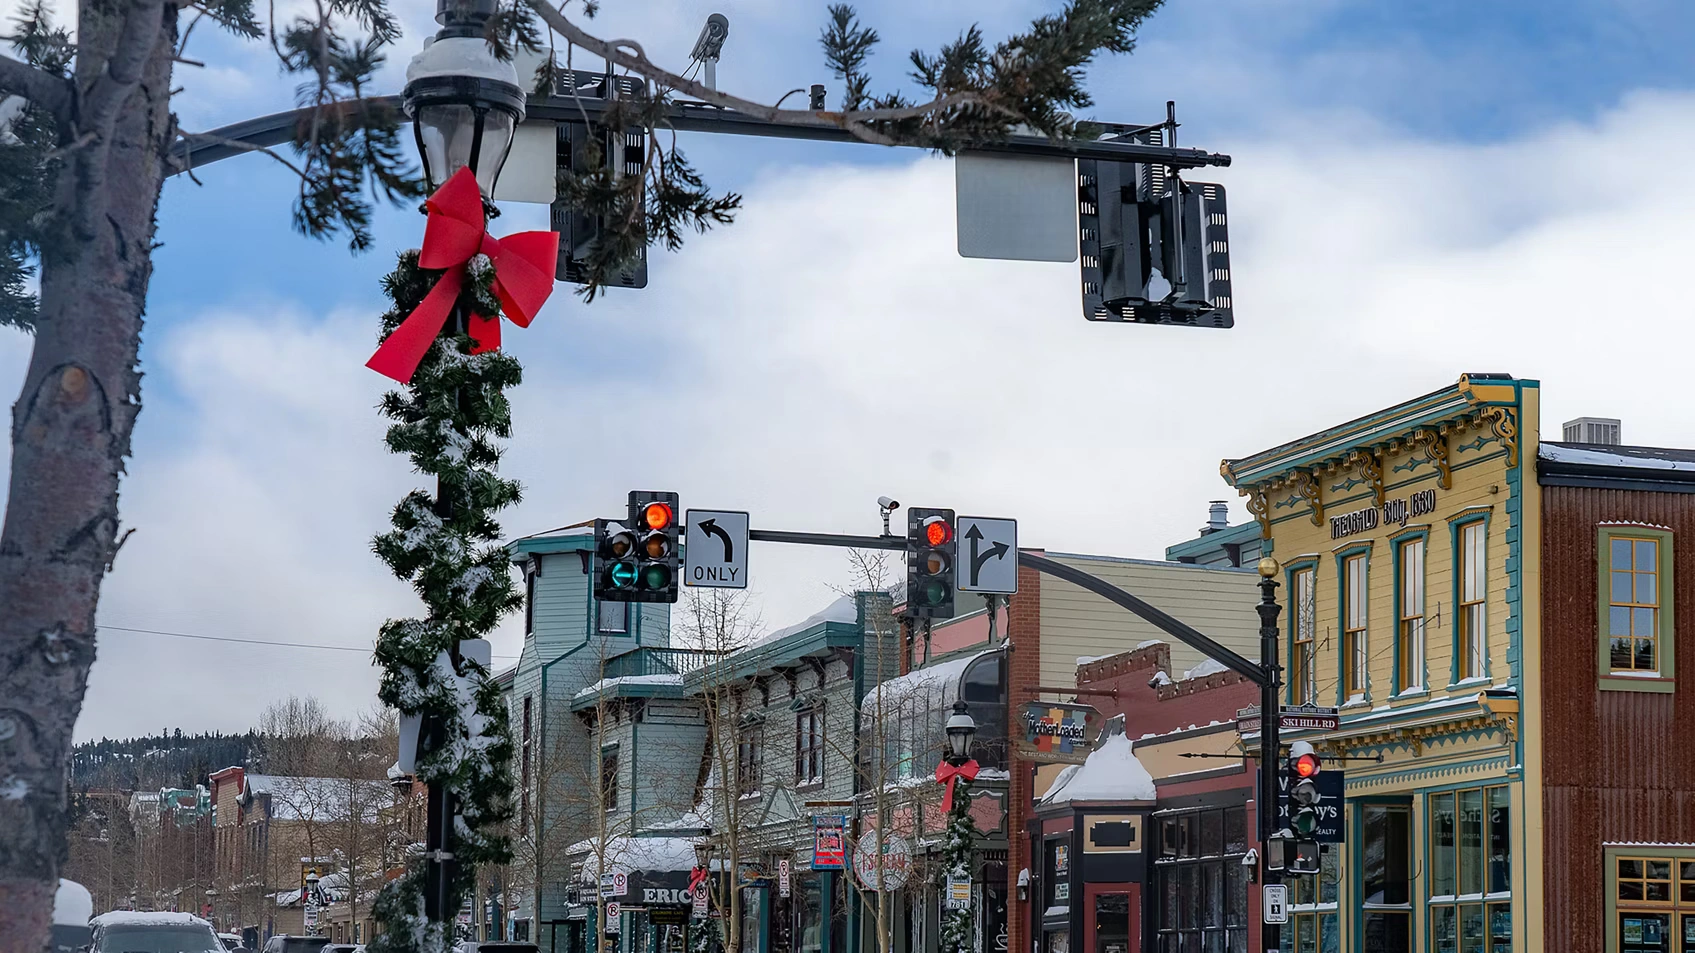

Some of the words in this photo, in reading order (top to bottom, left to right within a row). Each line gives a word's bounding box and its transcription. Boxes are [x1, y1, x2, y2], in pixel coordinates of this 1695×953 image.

[1330, 506, 1379, 540] THEOBALD
[1410, 489, 1436, 517] 1880
[694, 566, 739, 582] ONLY
[1028, 719, 1085, 738] MotherLoaded
[1282, 718, 1298, 727] SKI
[1299, 718, 1322, 728] HILL
[1322, 720, 1336, 728] RD
